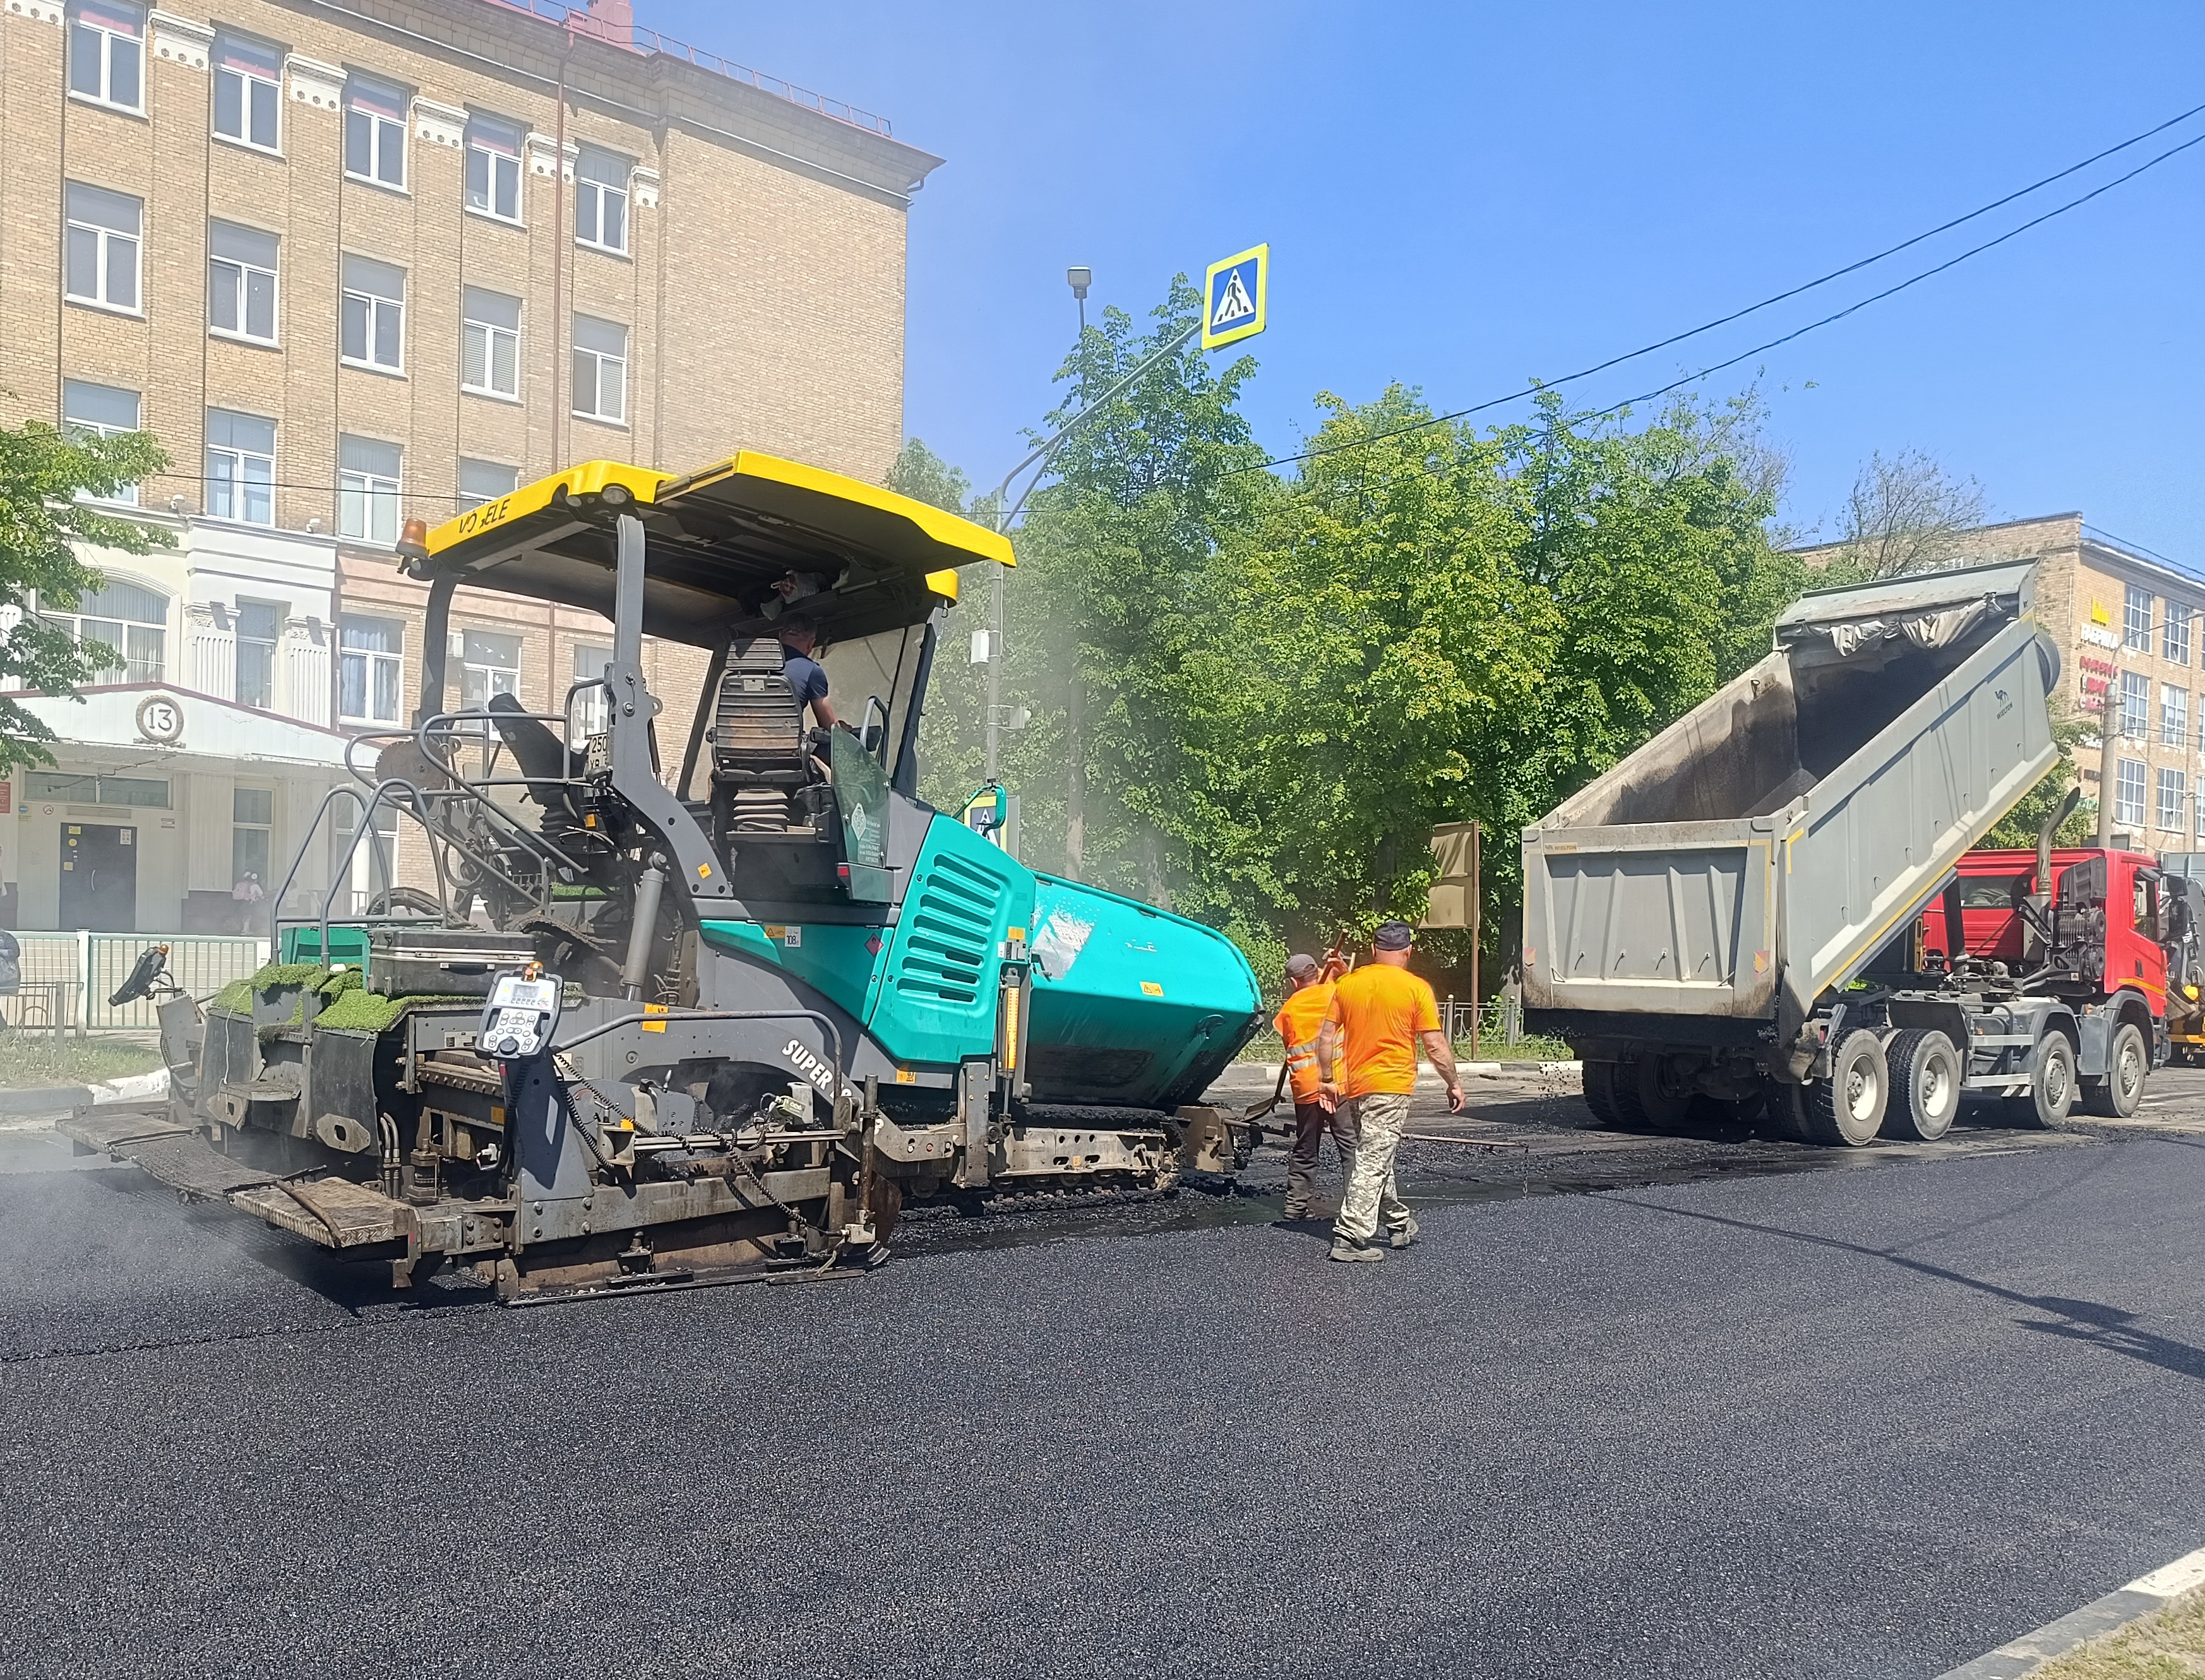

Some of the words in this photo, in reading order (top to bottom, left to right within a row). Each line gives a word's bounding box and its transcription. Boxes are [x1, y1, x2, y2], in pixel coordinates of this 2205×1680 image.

[148, 706, 172, 732] 13
[1997, 701, 2013, 720] WIELTON
[786, 935, 796, 945] 108
[782, 1039, 833, 1090] SUPER
